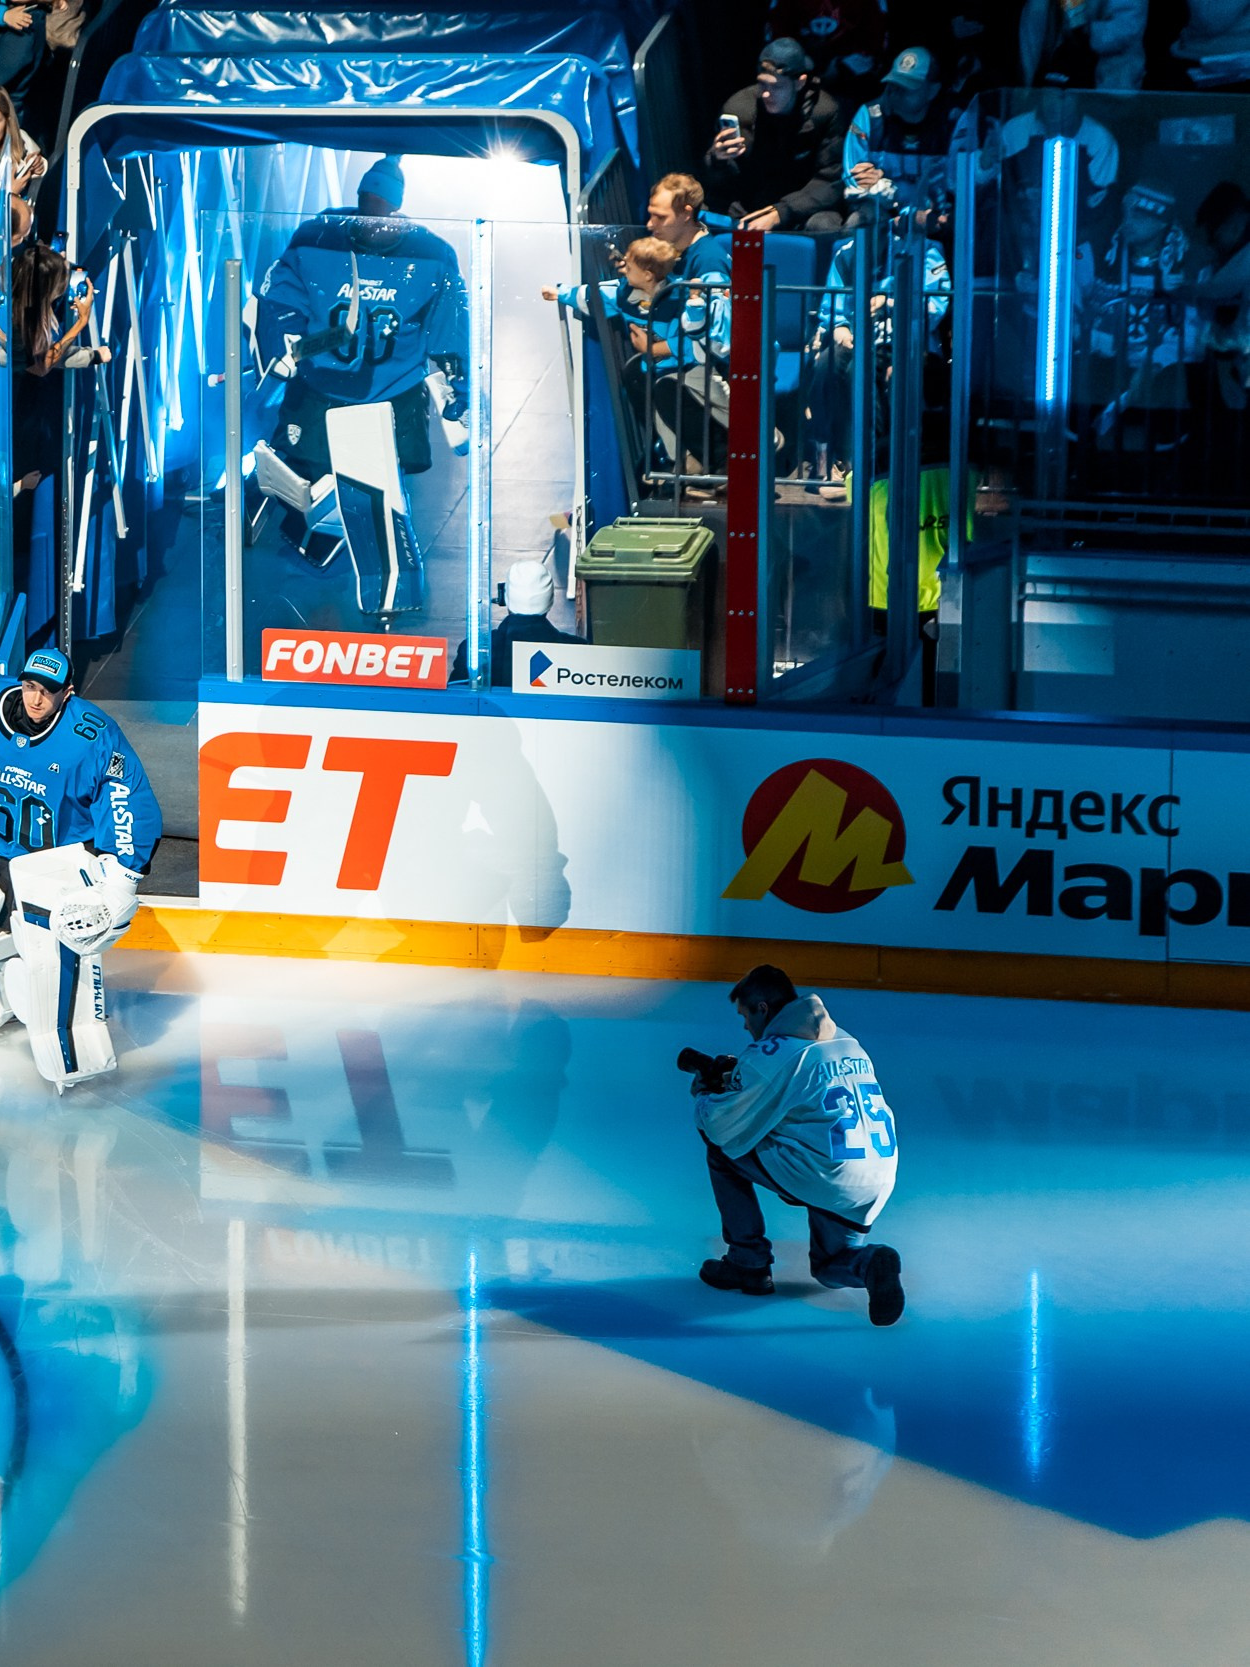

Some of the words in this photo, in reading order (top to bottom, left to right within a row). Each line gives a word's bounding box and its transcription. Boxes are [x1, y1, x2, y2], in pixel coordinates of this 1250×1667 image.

[265, 639, 443, 681] FONBET
[556, 666, 684, 691] Ростелеком
[73, 711, 107, 742] 60
[940, 775, 1182, 839] Яндекс
[822, 1082, 898, 1161] 25
